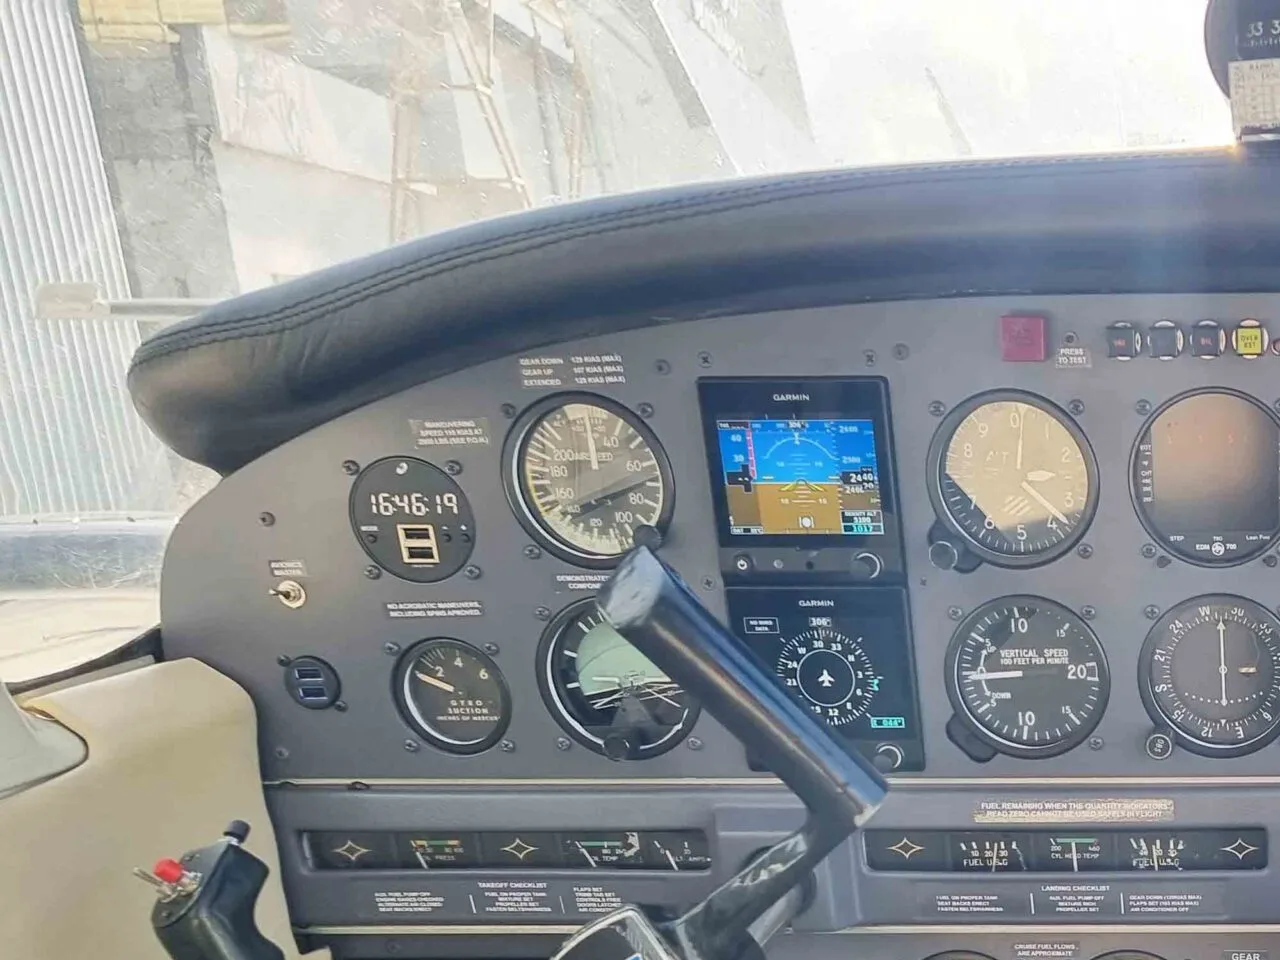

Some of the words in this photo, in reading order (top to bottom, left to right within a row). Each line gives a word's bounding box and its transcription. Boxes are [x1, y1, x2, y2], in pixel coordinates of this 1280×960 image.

[1060, 348, 1084, 356] PRESS
[1059, 356, 1068, 364] TO
[1069, 356, 1087, 364] TEST
[553, 449, 573, 461] 200
[550, 465, 568, 477] 180
[615, 512, 633, 523] 100
[1011, 618, 1028, 633] 10
[1169, 620, 1183, 633] 24
[1000, 649, 1038, 658] VERTICAL
[1044, 649, 1068, 658] SPEED
[1154, 649, 1166, 661] 21
[1067, 664, 1087, 680] 20
[1018, 711, 1035, 726] 10
[1154, 738, 1165, 753] OBS
[1232, 953, 1261, 960] GEAR
